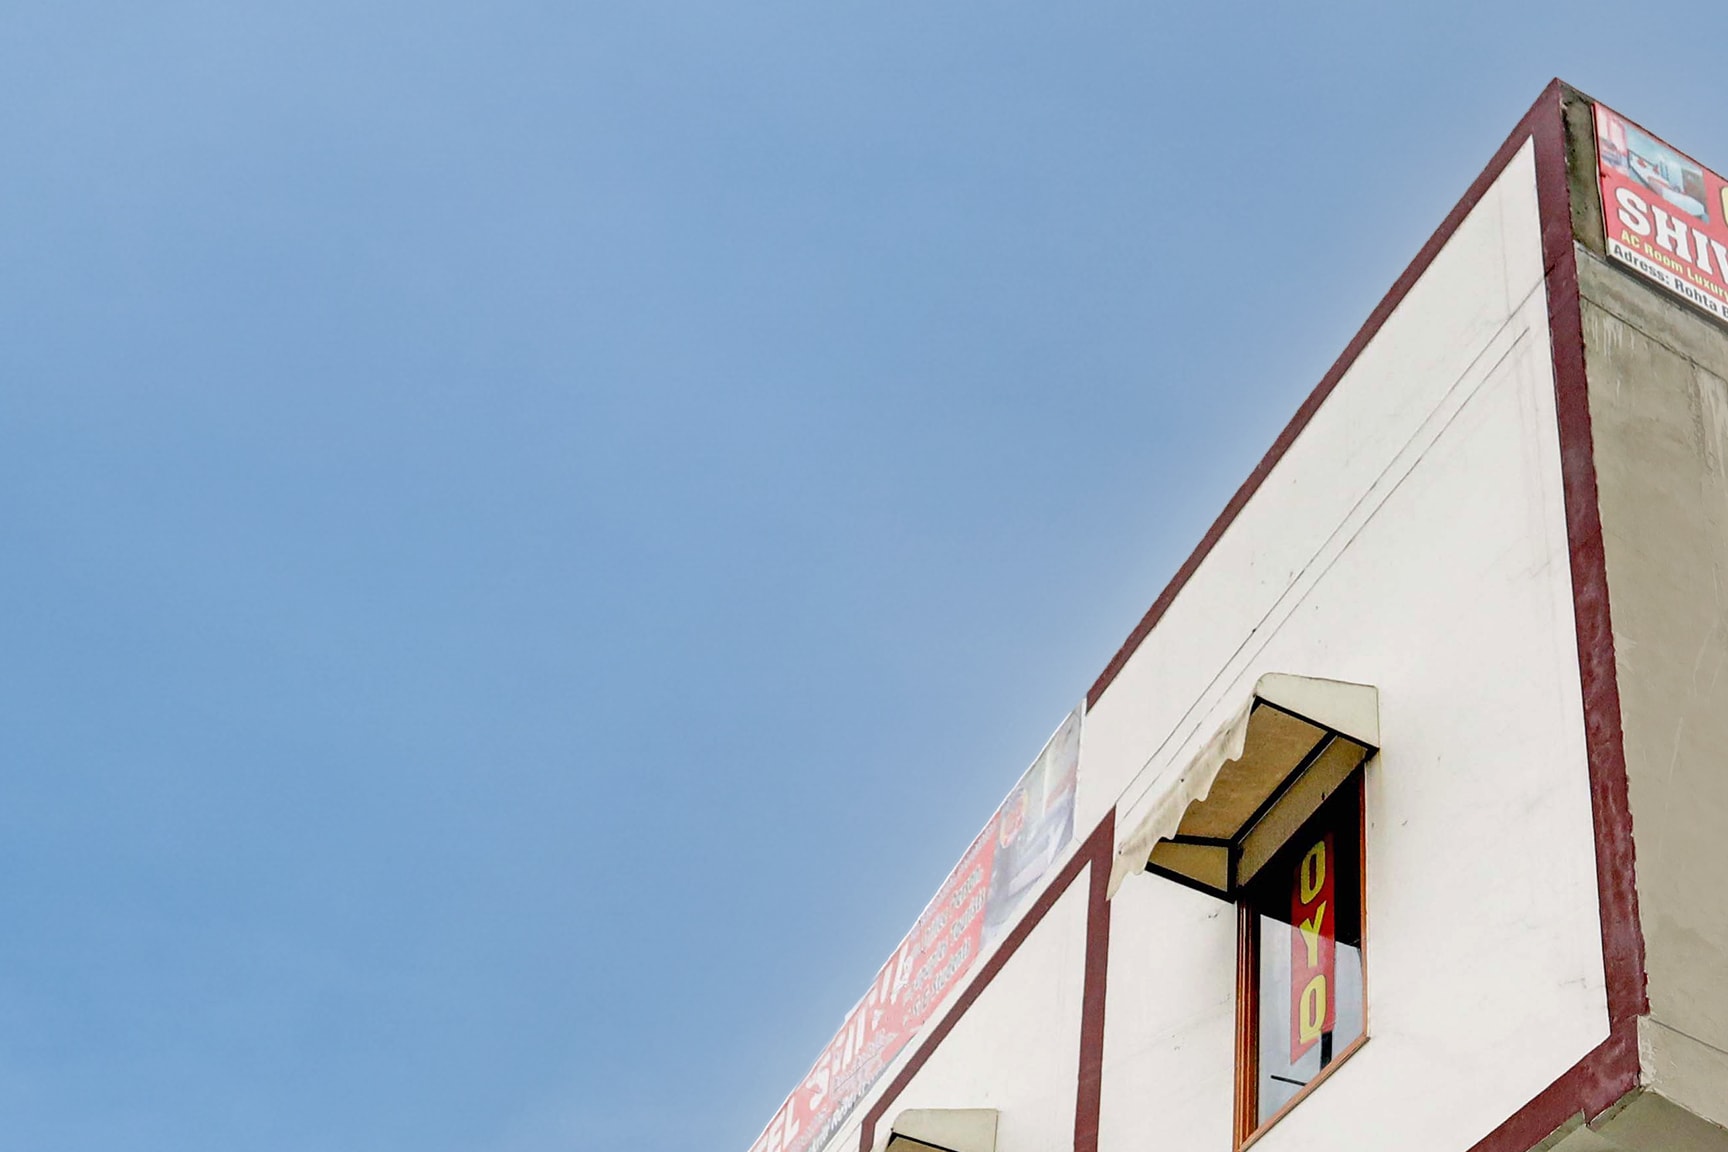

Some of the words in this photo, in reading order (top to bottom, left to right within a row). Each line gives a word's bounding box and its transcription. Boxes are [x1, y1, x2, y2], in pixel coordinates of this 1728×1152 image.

[1620, 230, 1640, 249] AC
[1644, 242, 1684, 274] Room
[1674, 280, 1718, 313] Rohta
[1299, 840, 1327, 1046] OYO
